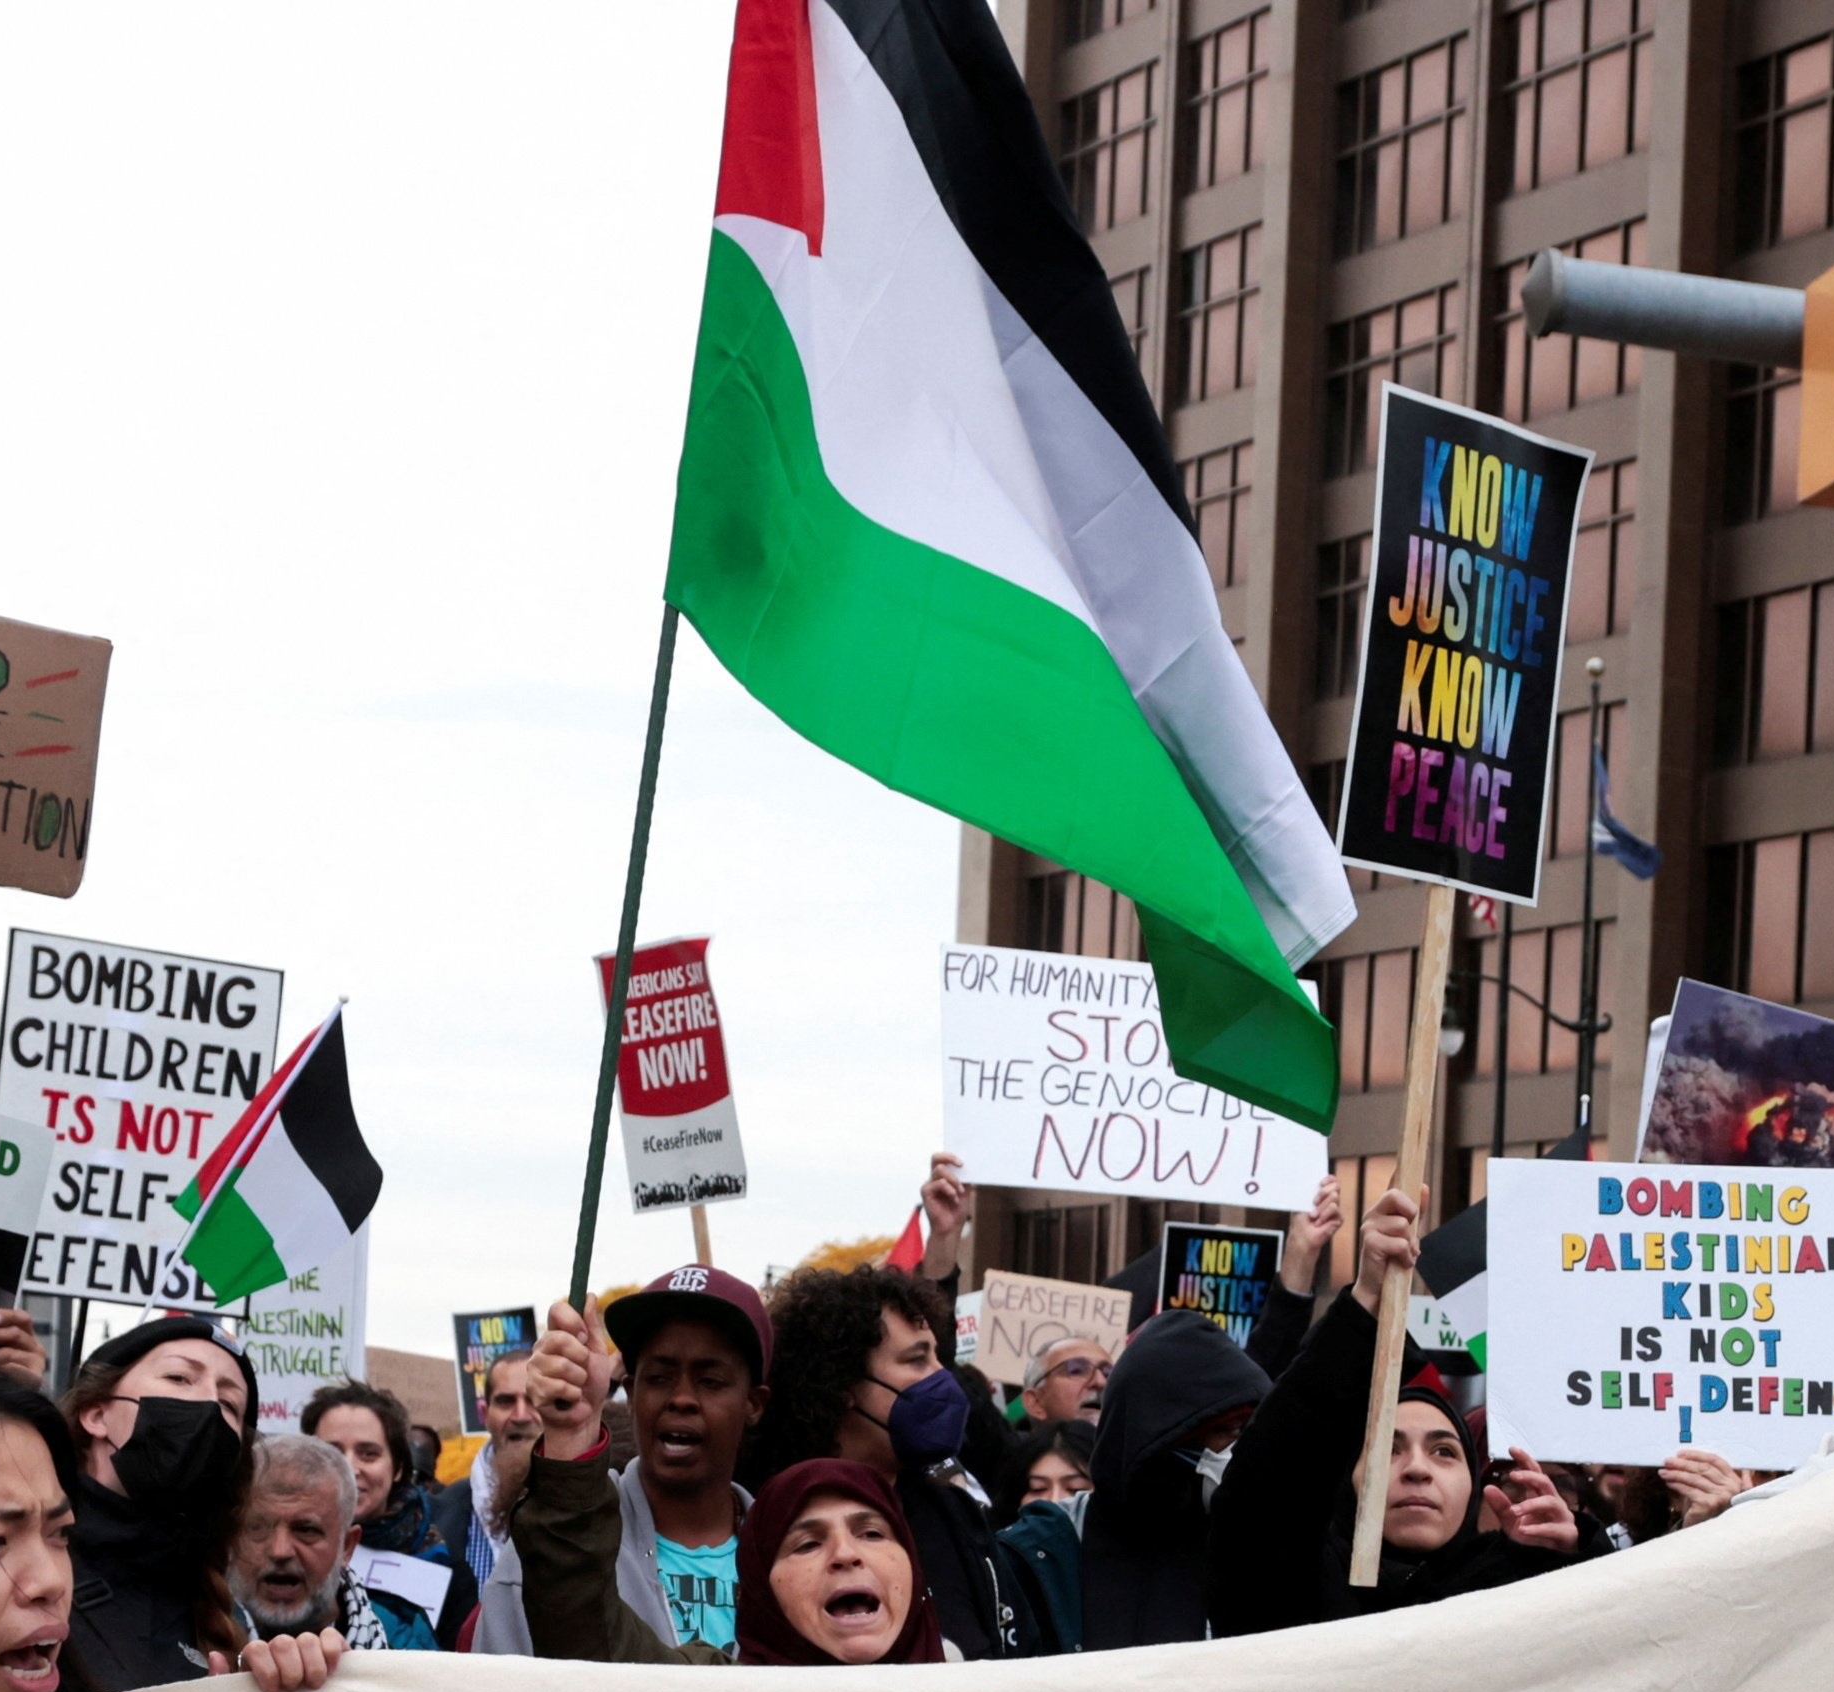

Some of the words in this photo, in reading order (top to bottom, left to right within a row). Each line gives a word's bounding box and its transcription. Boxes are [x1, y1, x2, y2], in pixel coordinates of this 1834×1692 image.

[1419, 436, 1542, 562] KNOW
[1388, 535, 1550, 667] JUSTICE
[1397, 639, 1523, 759] KNOW
[1384, 741, 1512, 860] PEACE
[28, 945, 257, 1029] BOMBING
[626, 966, 685, 998] MERICANS
[686, 961, 705, 986] SAY
[944, 952, 999, 993] FOR
[622, 991, 716, 1044] EASEFIRE
[1046, 1010, 1171, 1068] STO
[9, 1017, 261, 1101] CHILDREN
[637, 1037, 707, 1091] NOW!
[949, 1056, 1033, 1100] THE
[41, 1088, 96, 1144] IS
[116, 1099, 214, 1159] NOT
[643, 1127, 723, 1154] #CeaseFireNow
[52, 1161, 178, 1223] SELF-
[1598, 1177, 1810, 1225] BOMBING
[24, 1231, 217, 1302] EFENS
[1185, 1238, 1259, 1277] KNOW
[987, 1280, 1126, 1327] CEASEFIRE
[1170, 1274, 1266, 1314] JUSTICE
[1663, 1281, 1775, 1322] KIDS
[469, 1316, 522, 1344] KNOW
[989, 1315, 1119, 1358] NO
[1620, 1326, 1662, 1363] IS
[1690, 1327, 1781, 1367] NOT
[1567, 1370, 1673, 1410] SELF
[1679, 1406, 1692, 1443] !
